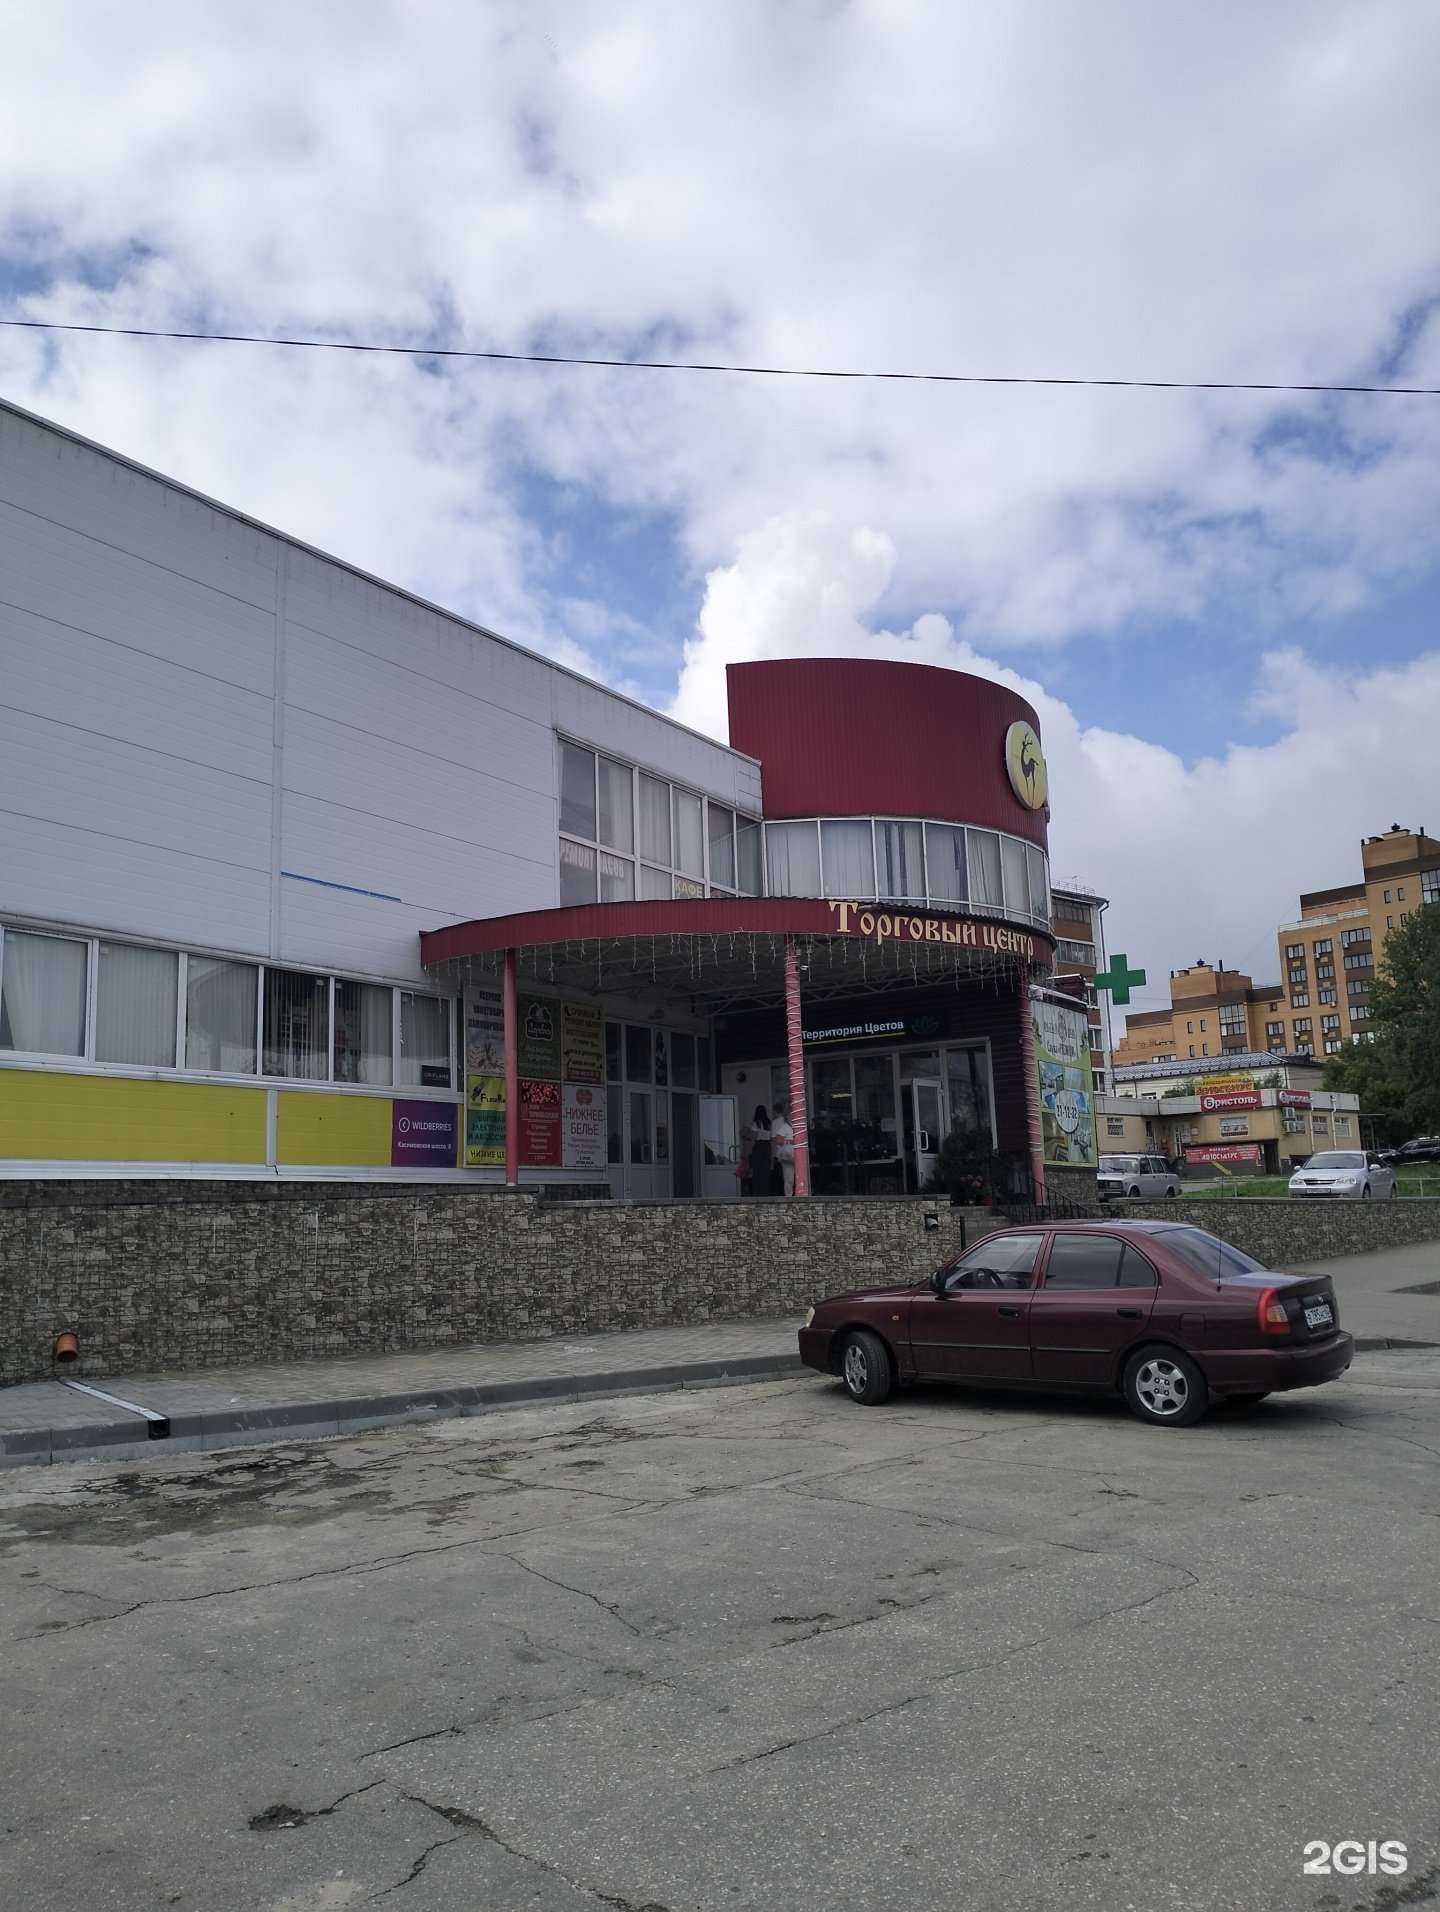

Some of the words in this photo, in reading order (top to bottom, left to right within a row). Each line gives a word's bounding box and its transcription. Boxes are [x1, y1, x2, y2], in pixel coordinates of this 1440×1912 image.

[600, 852, 624, 878] АСОВ
[674, 879, 703, 898] КАФЕ
[828, 900, 976, 946] Торговый
[802, 1025, 863, 1041] Территория
[865, 1020, 905, 1035] Цветов
[1204, 1095, 1257, 1109] Бристоль
[565, 1106, 603, 1122] НИЖНЕЕ
[412, 1120, 452, 1132] WILDBERRIES
[570, 1122, 600, 1136] БЕЛЬЕ
